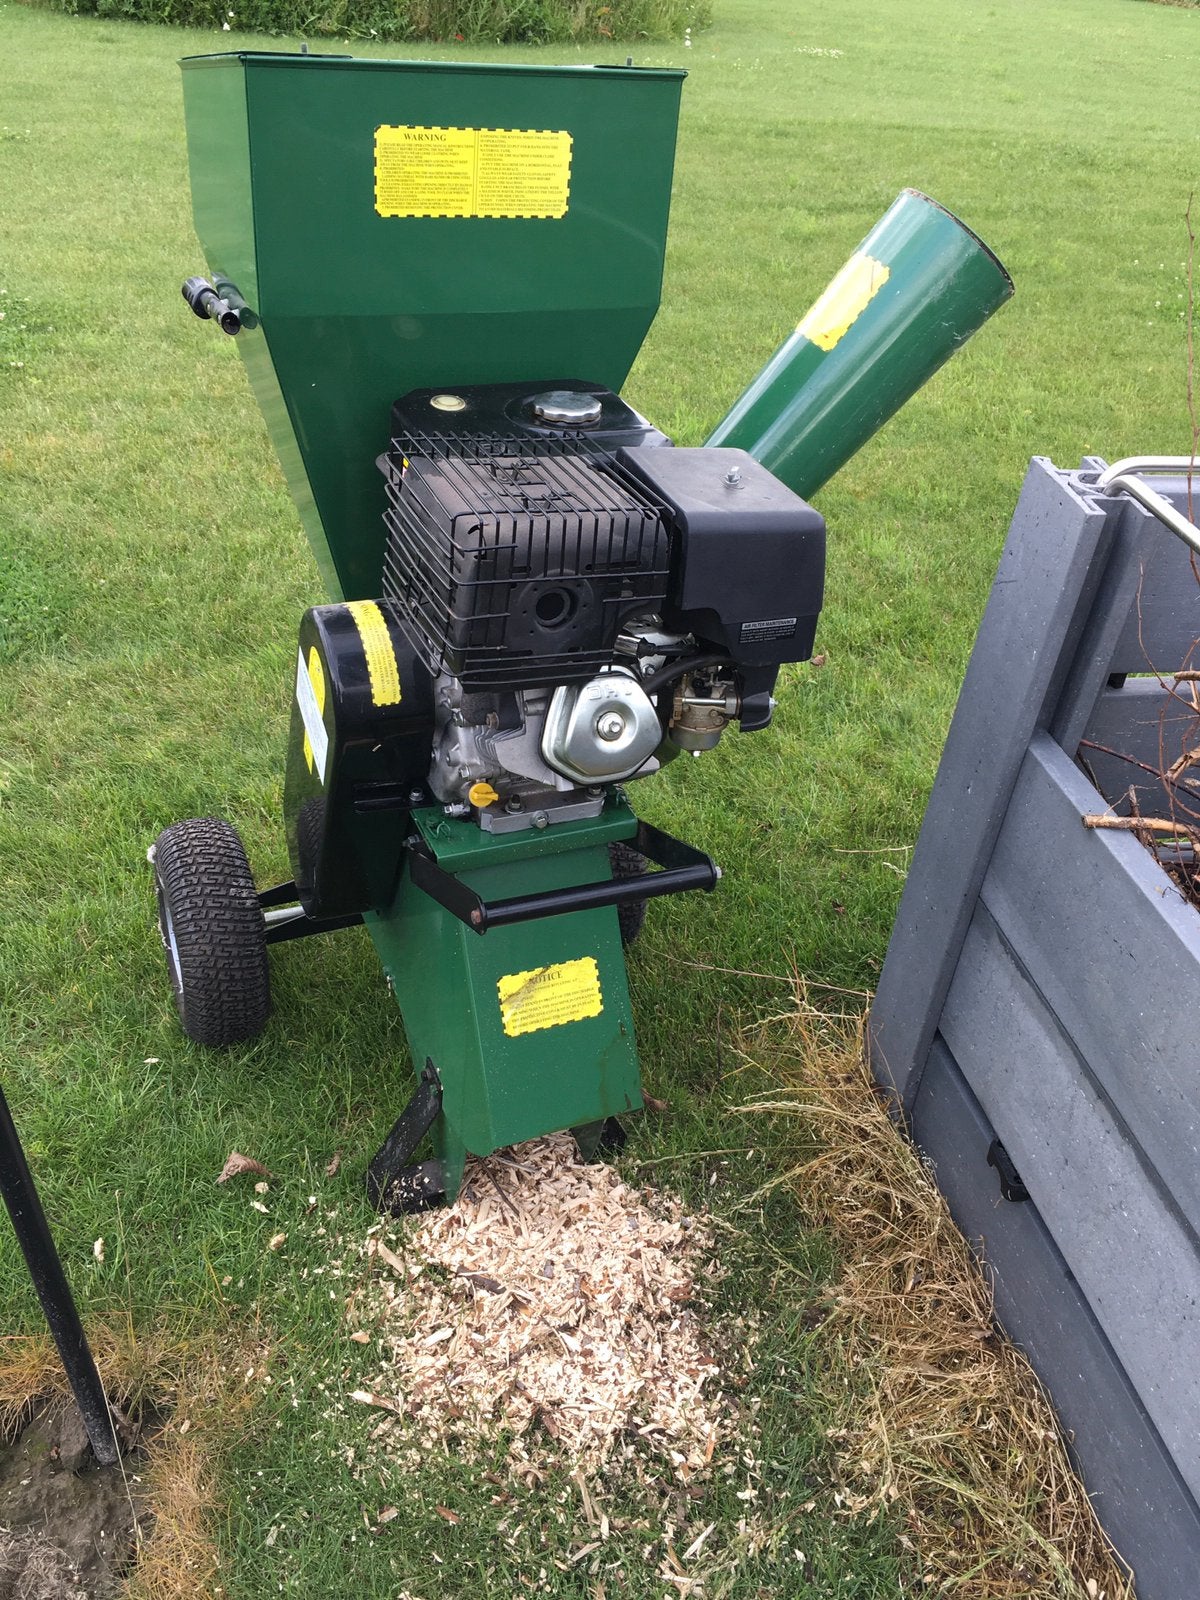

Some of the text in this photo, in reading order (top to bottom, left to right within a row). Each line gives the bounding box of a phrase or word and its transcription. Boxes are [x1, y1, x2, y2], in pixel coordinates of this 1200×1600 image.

[404, 133, 447, 142] WARNING
[766, 618, 795, 627] MAINTENANCE
[528, 970, 564, 985] NOTICE
